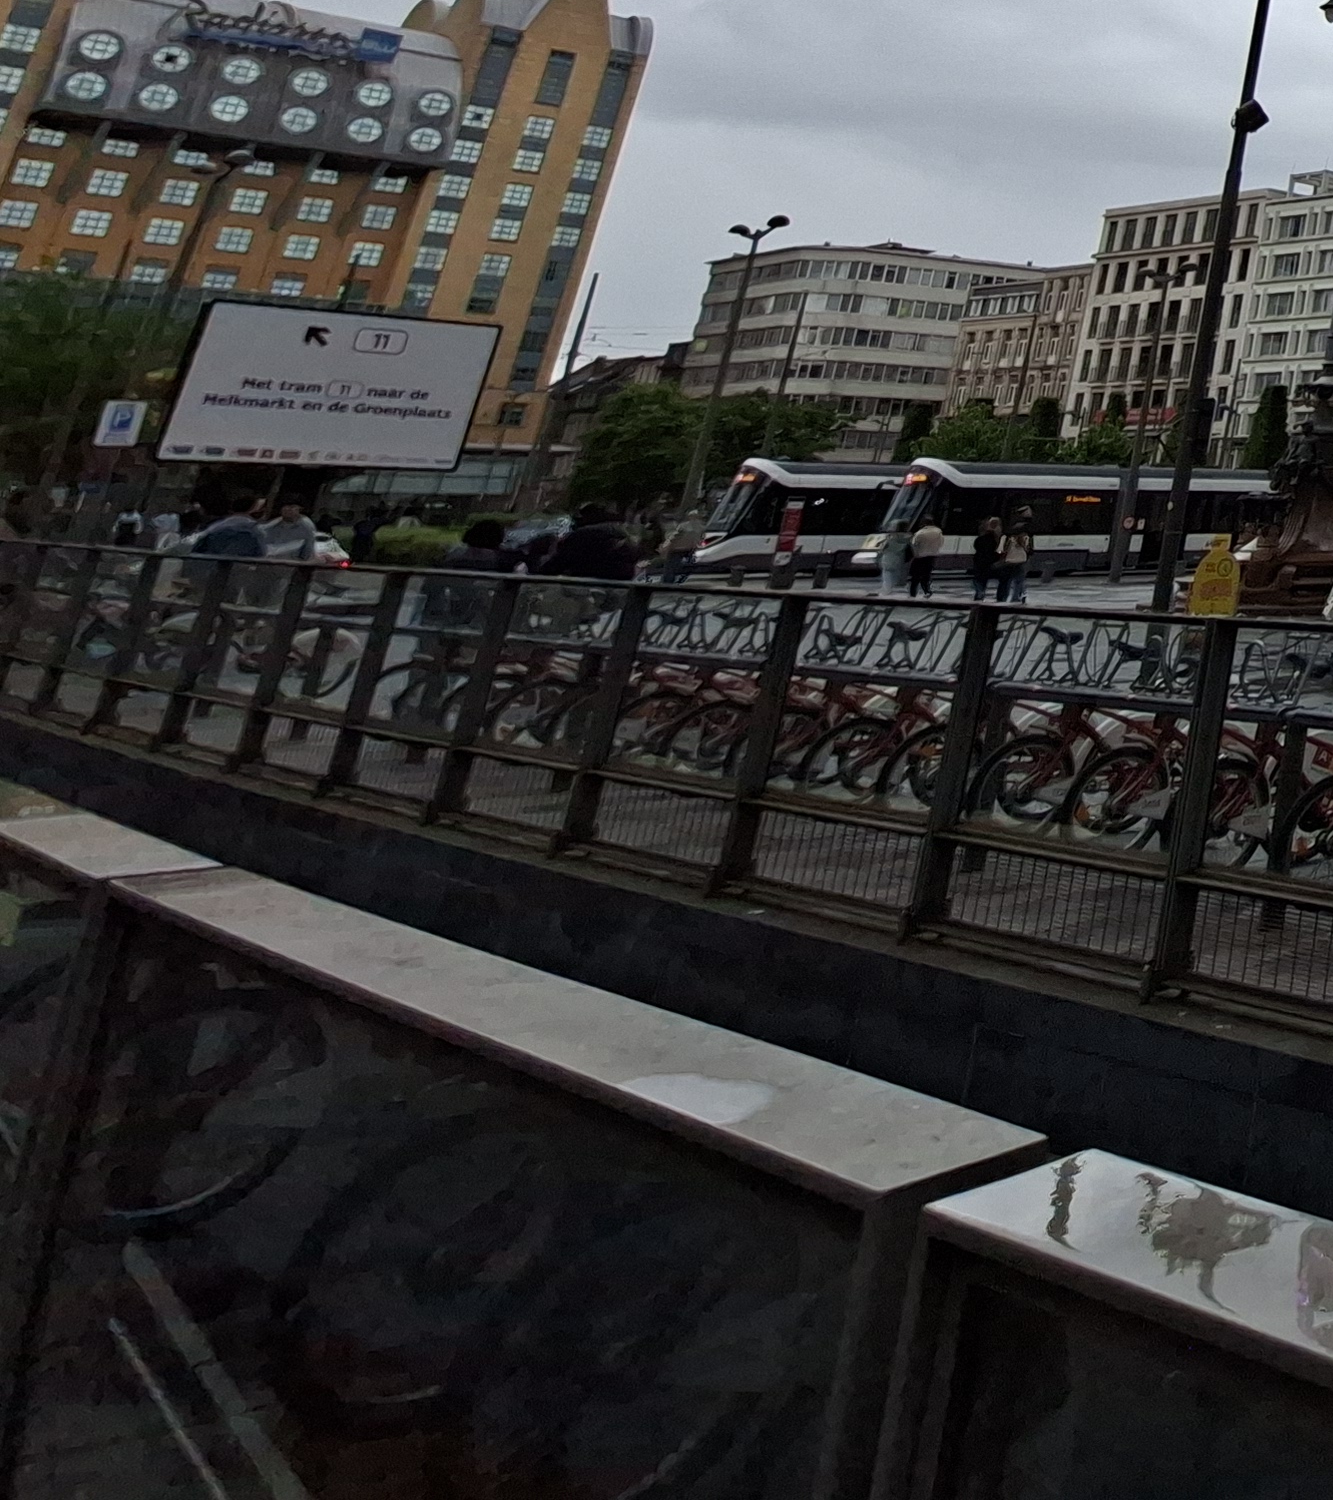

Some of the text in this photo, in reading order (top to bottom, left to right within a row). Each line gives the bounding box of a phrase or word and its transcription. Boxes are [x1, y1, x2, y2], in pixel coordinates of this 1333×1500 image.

[374, 333, 391, 350] 11
[241, 378, 272, 390] Met
[280, 381, 323, 393] tram
[367, 387, 405, 399] naar
[410, 390, 429, 400] de
[202, 393, 452, 419] Melkmarkt en de Groenplaats
